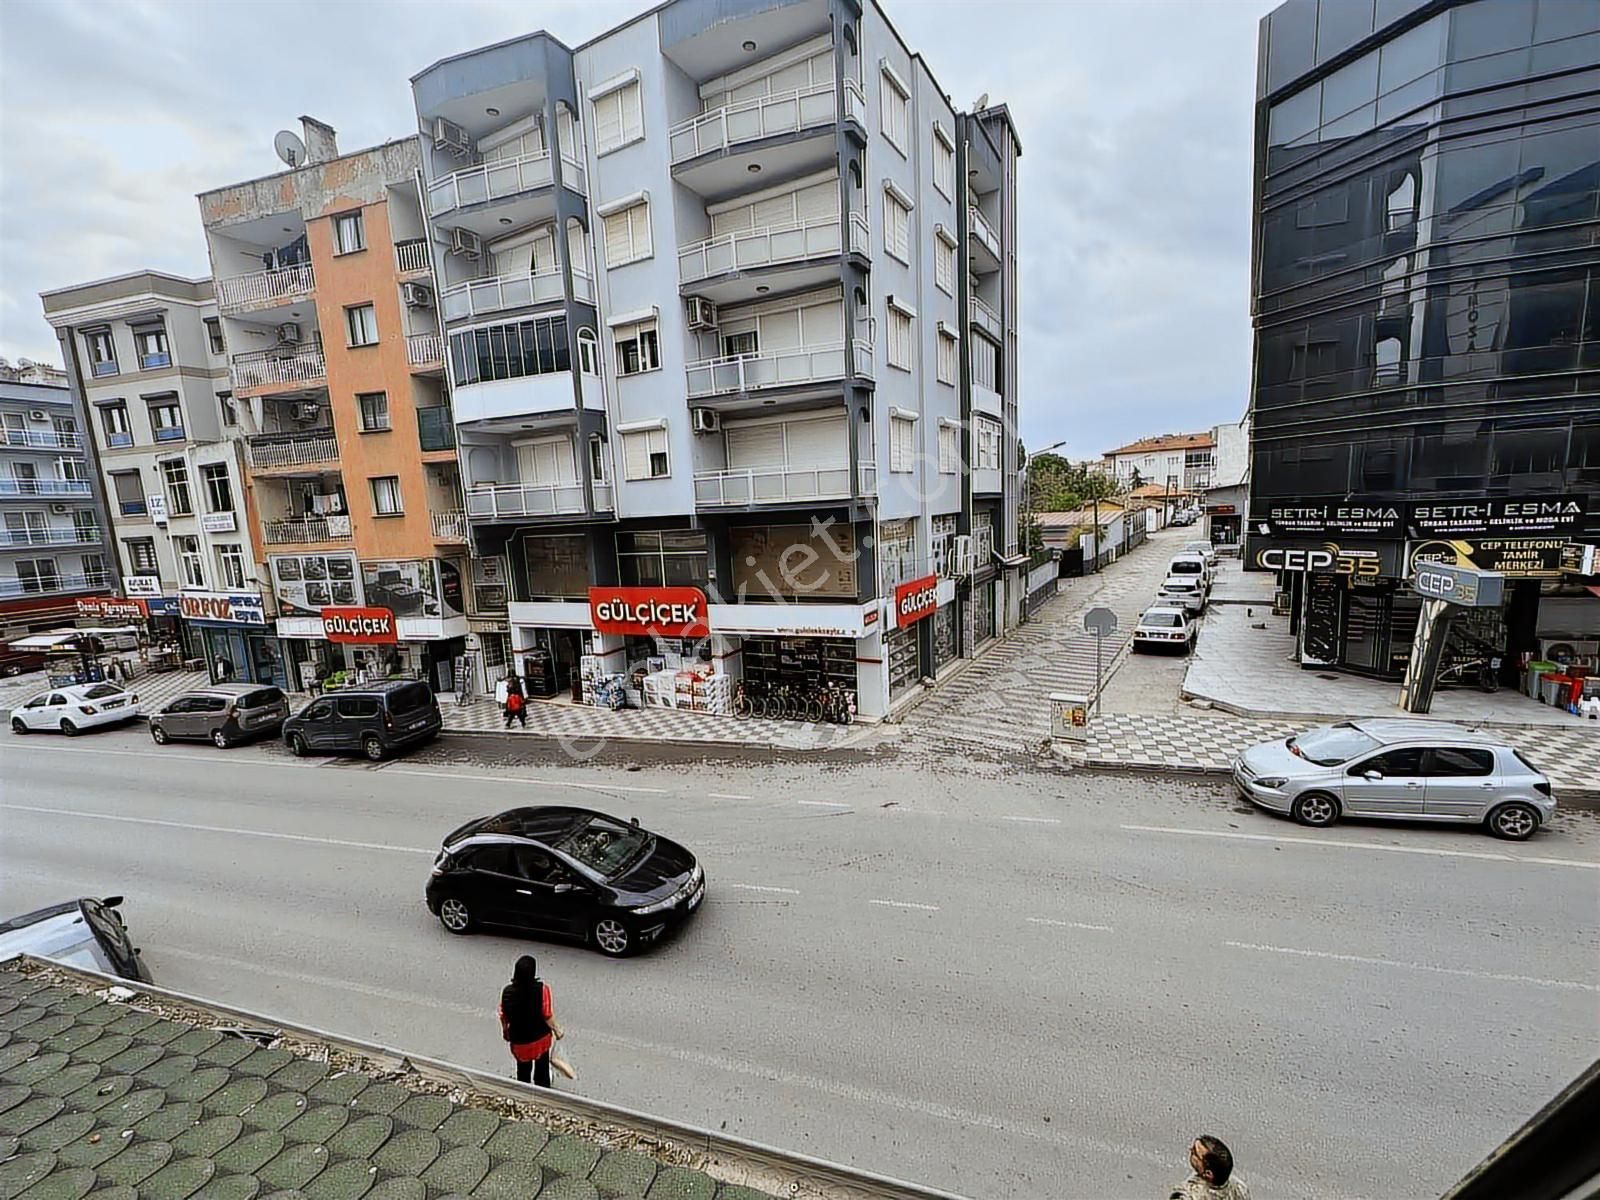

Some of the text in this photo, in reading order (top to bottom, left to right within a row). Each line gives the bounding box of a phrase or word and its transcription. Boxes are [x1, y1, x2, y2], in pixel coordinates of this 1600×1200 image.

[1337, 507, 1399, 519] ESMA
[1504, 501, 1581, 516] ESMA
[1481, 540, 1564, 550] CEP TELEFONU
[1502, 550, 1539, 559] TAMİR
[1494, 558, 1544, 570] MERKEZİ
[596, 598, 698, 626] GÜLÇİÇEK
[325, 614, 391, 635] GÜLÇİÇEK
